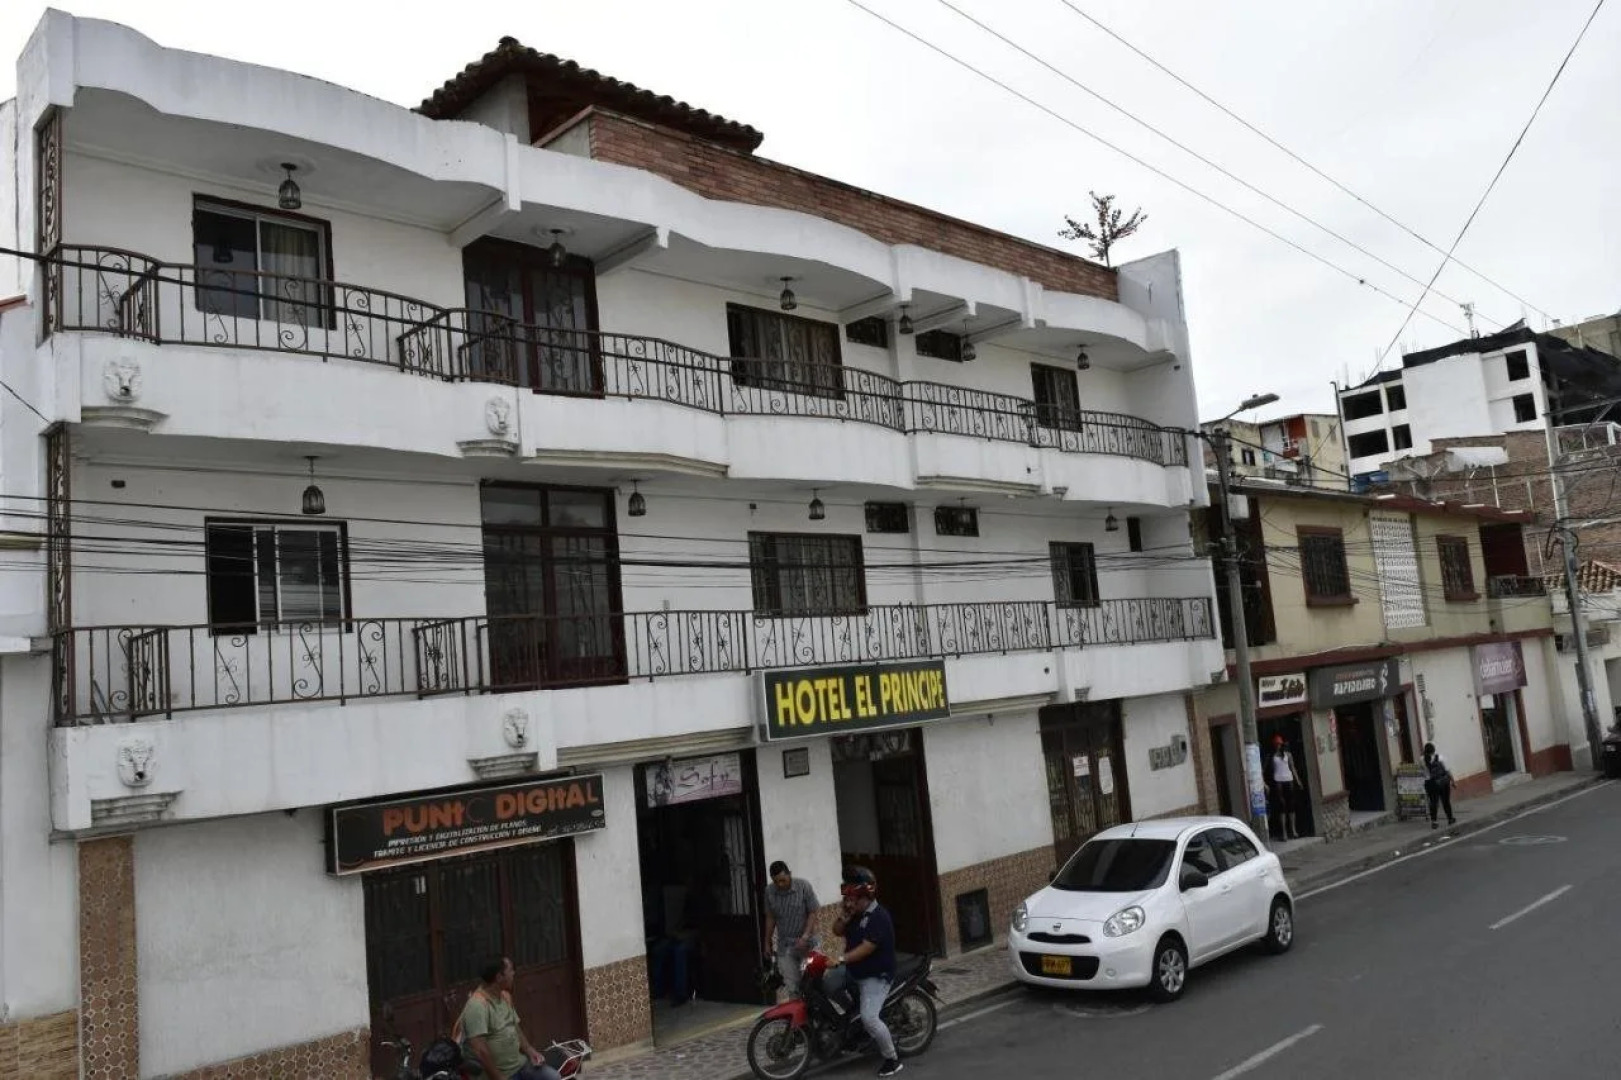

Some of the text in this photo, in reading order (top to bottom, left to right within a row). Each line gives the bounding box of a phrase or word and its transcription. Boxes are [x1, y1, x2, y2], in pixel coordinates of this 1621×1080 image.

[775, 669, 945, 726] HOTEL EL PRINCIPE
